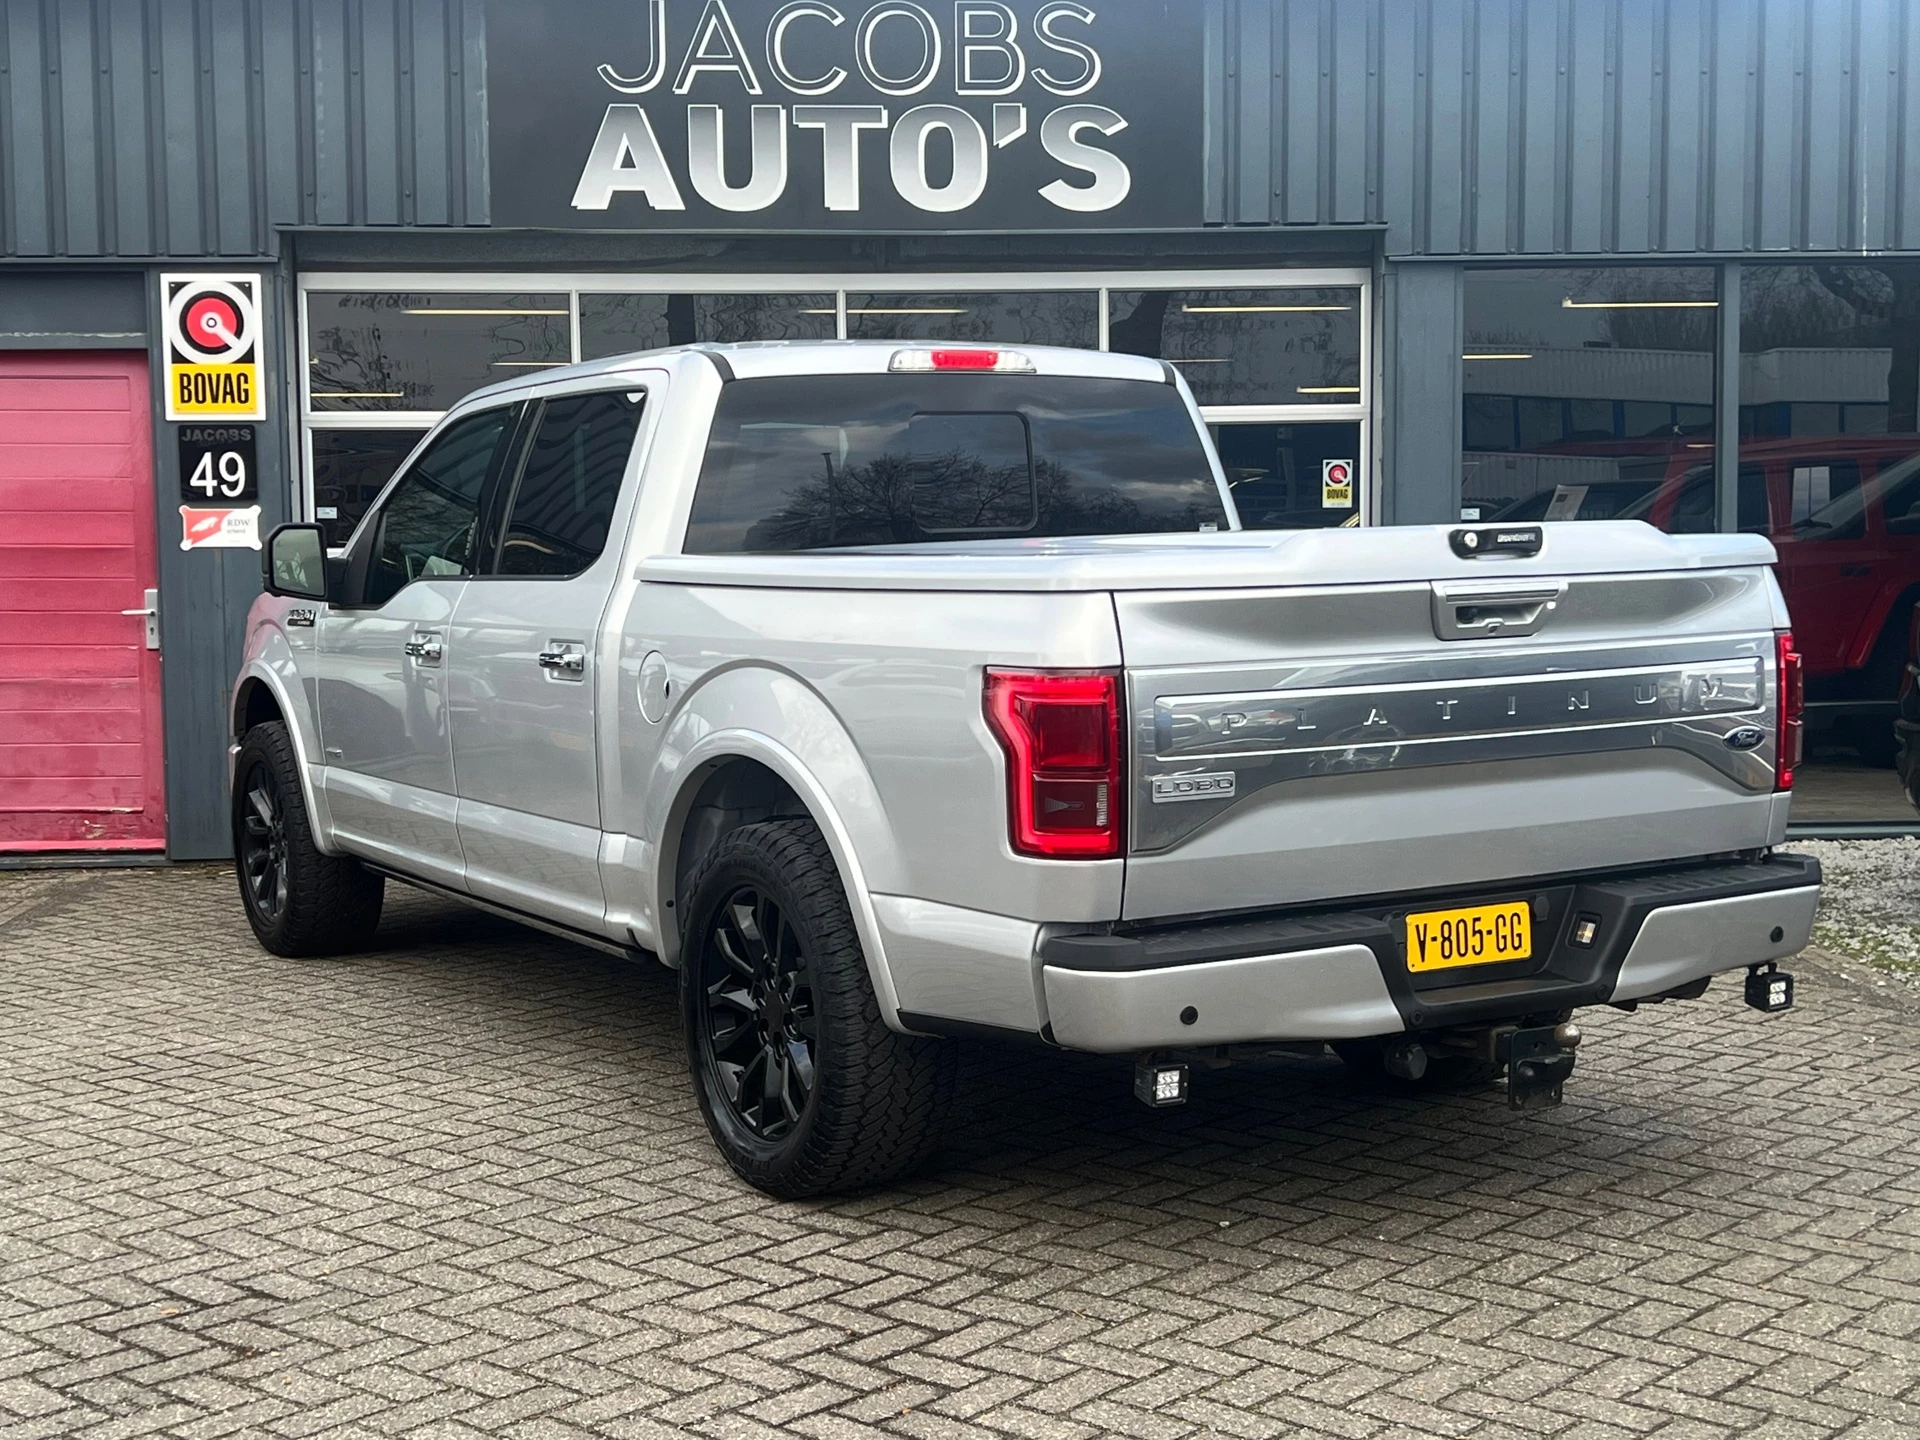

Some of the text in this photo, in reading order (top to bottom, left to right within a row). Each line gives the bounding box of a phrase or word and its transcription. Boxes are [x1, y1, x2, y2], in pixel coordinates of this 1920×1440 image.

[597, 0, 1101, 95] JACOBS
[570, 103, 1131, 212] AUTO'S
[178, 372, 250, 404] BOVAG
[182, 429, 252, 442] JACOBS
[189, 451, 246, 498] 49
[1326, 488, 1349, 500] BOVAG
[1221, 675, 1725, 736] PLATINUM
[1414, 911, 1523, 963] V-805-GG
